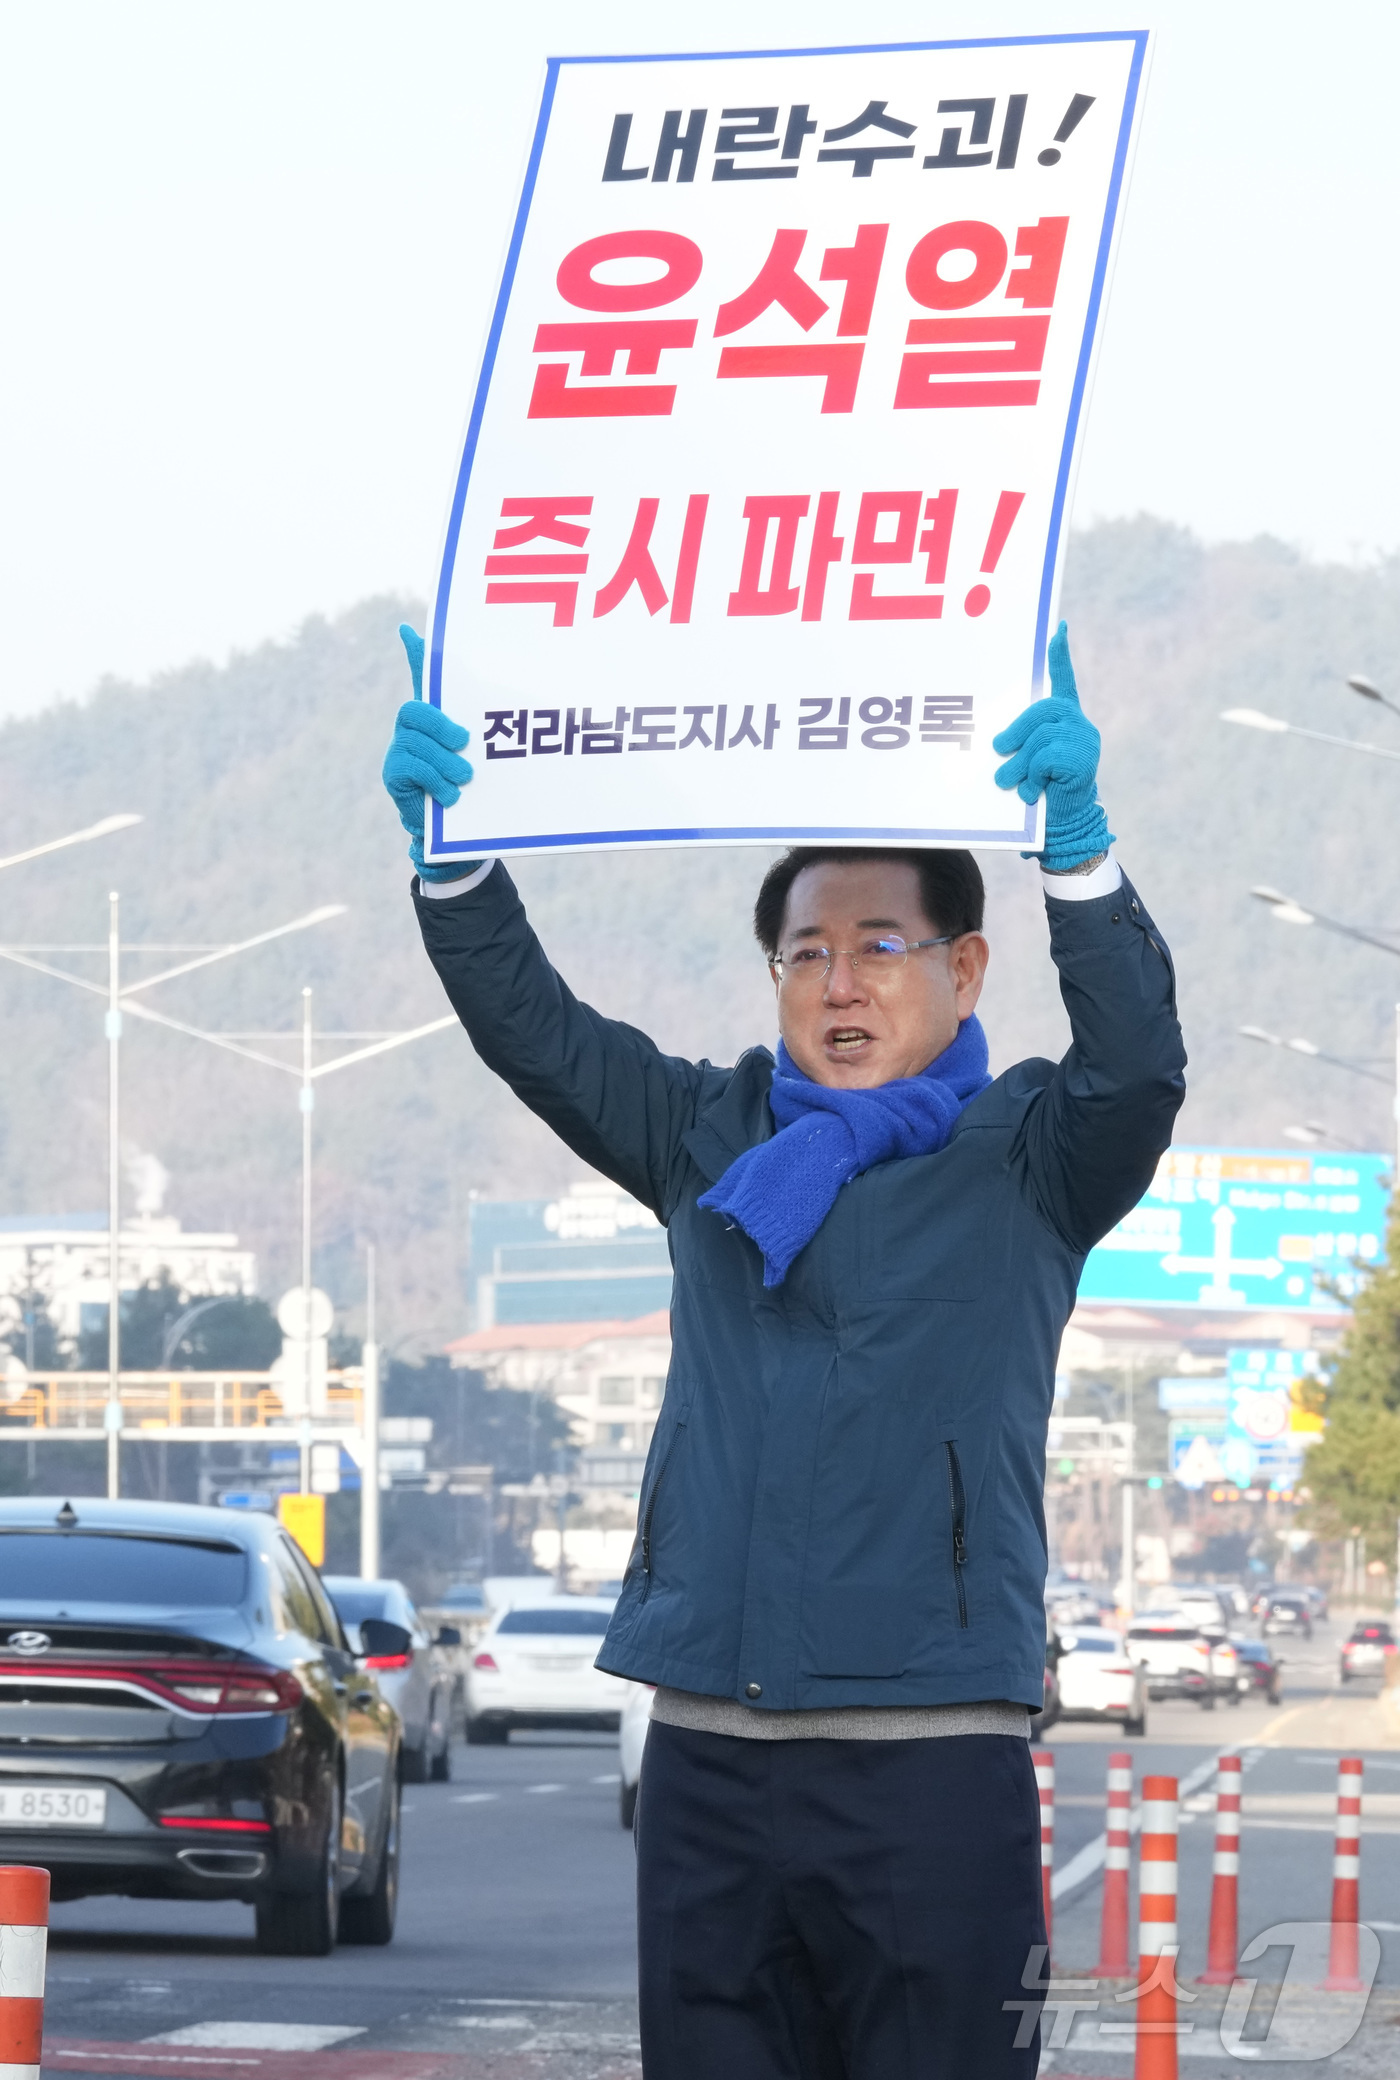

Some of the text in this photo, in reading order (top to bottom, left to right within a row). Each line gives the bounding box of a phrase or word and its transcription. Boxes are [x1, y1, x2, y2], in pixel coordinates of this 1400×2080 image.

[602, 93, 1095, 183] 내란수괴!
[528, 216, 1069, 419] 윤석열
[484, 489, 1025, 627] 즉시 파면!
[484, 696, 973, 760] 전라남도지사 김영록
